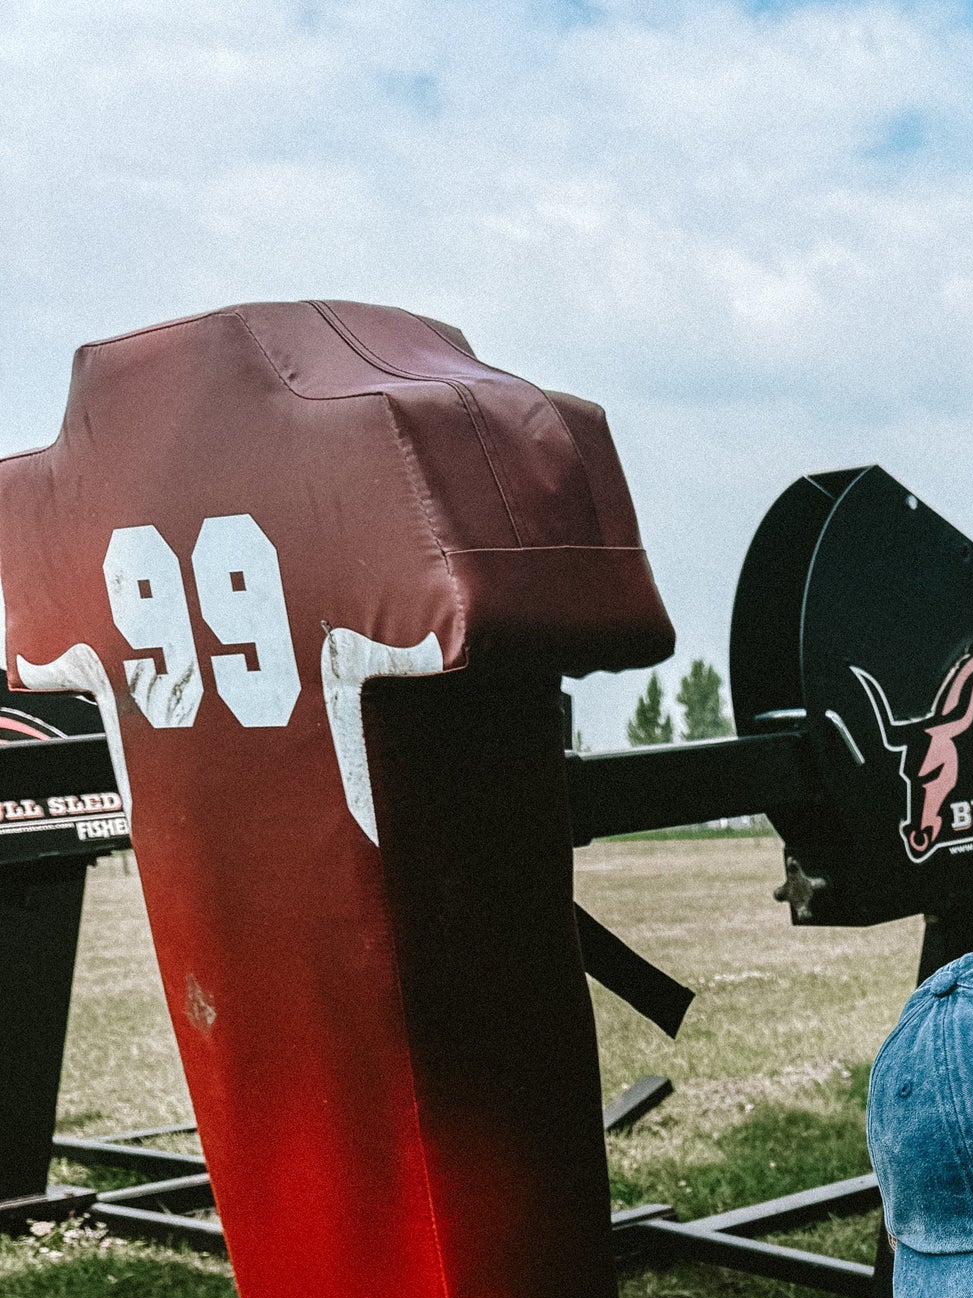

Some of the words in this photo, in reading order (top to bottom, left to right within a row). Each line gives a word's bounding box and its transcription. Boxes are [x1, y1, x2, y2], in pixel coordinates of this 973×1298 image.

[102, 513, 302, 729] 99
[0, 799, 45, 820] LL
[46, 792, 122, 817] SLED
[75, 817, 130, 841] FISHE
